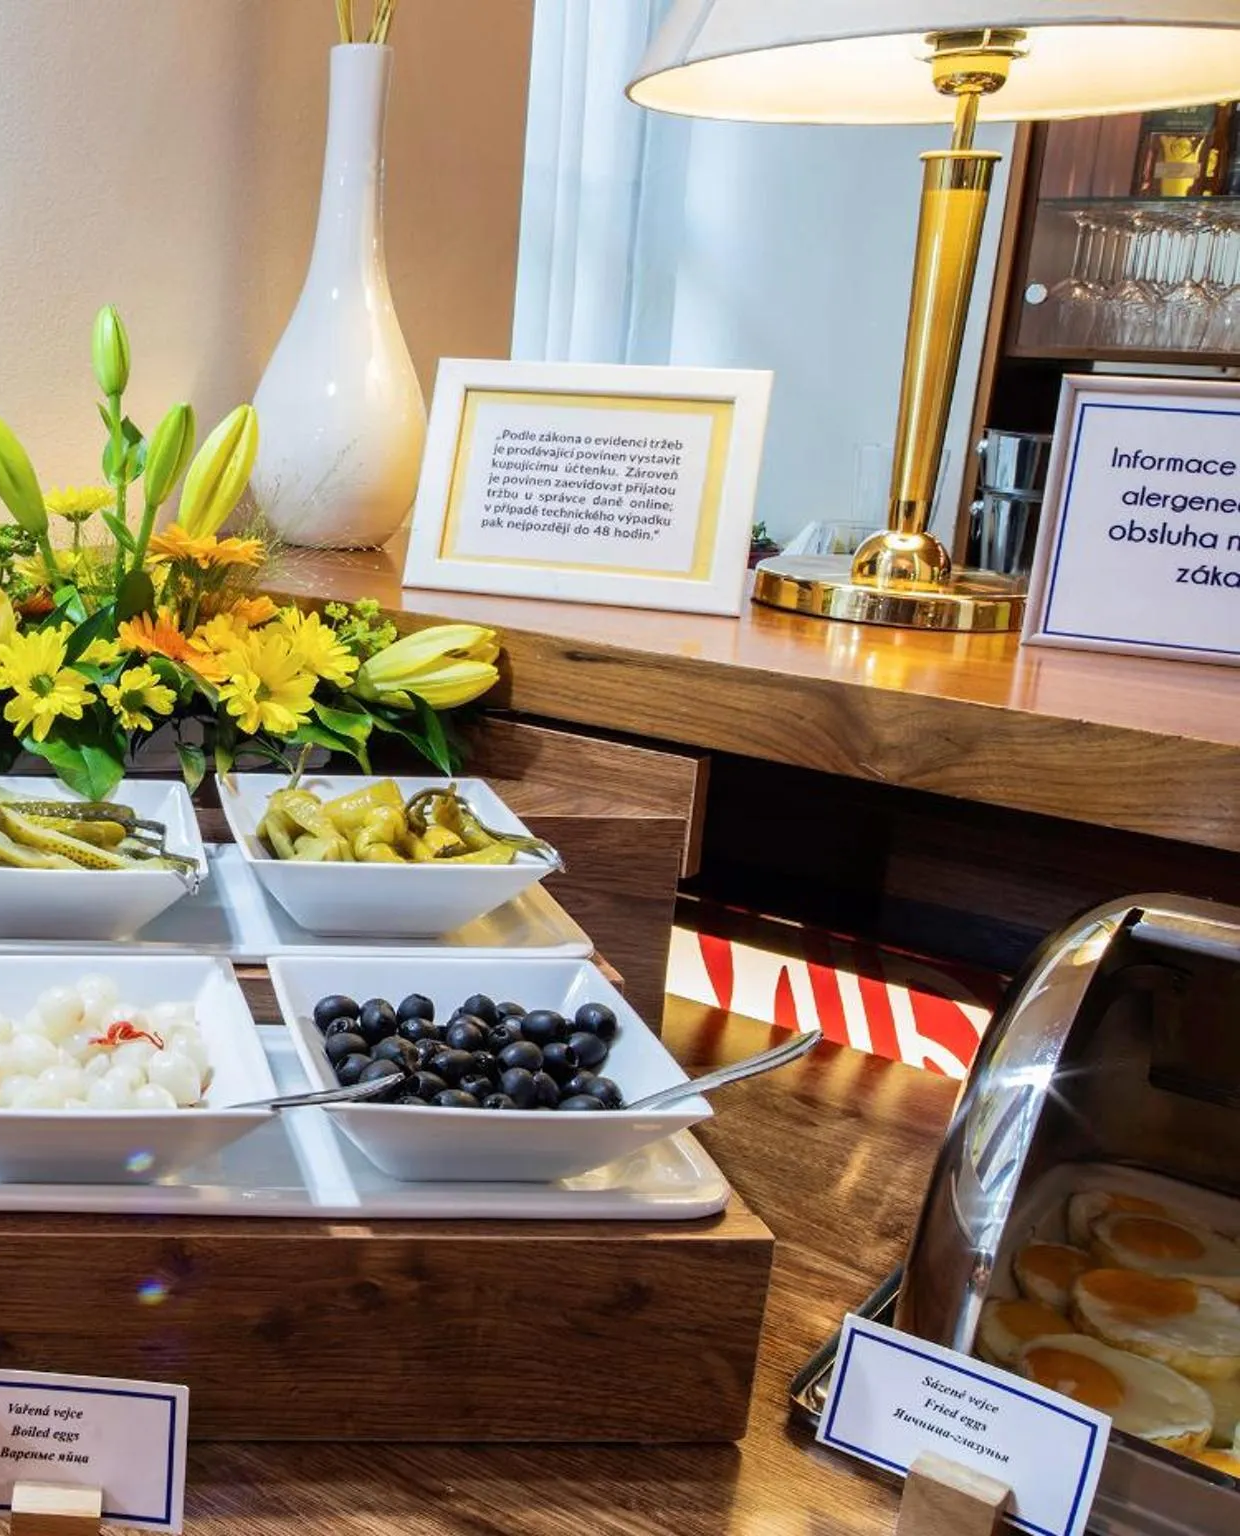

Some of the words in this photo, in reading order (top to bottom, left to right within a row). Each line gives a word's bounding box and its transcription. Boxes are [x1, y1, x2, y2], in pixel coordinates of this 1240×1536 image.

[538, 431, 581, 444] zákona
[584, 436, 592, 444] o
[595, 436, 647, 447] evidenci
[649, 439, 683, 450] tržeb
[493, 443, 504, 455] je
[576, 450, 626, 461] povinen
[629, 454, 681, 465] vystavit
[1111, 447, 1236, 476] Informace
[488, 472, 500, 485] je
[502, 475, 551, 487] povinen
[554, 478, 622, 491] zaevidovat
[625, 466, 678, 480] Zároveň
[487, 488, 518, 500] tržbu
[525, 491, 533, 500] u
[539, 493, 586, 504] správce
[593, 495, 623, 507] daně
[1122, 486, 1240, 513] alergene
[484, 503, 492, 512] v
[541, 507, 615, 521] technického
[618, 512, 671, 526] výpadku
[480, 517, 503, 529] pak
[573, 524, 589, 535] do
[593, 525, 610, 536] 48
[1109, 519, 1218, 549] obsluha
[8, 1403, 50, 1416] Vařená
[54, 1407, 84, 1421] vejce
[968, 1395, 1000, 1413] vejce
[924, 1398, 959, 1418] Fried
[960, 1415, 987, 1432] eggs
[11, 1425, 50, 1438] Boiled
[52, 1430, 80, 1443] eggs
